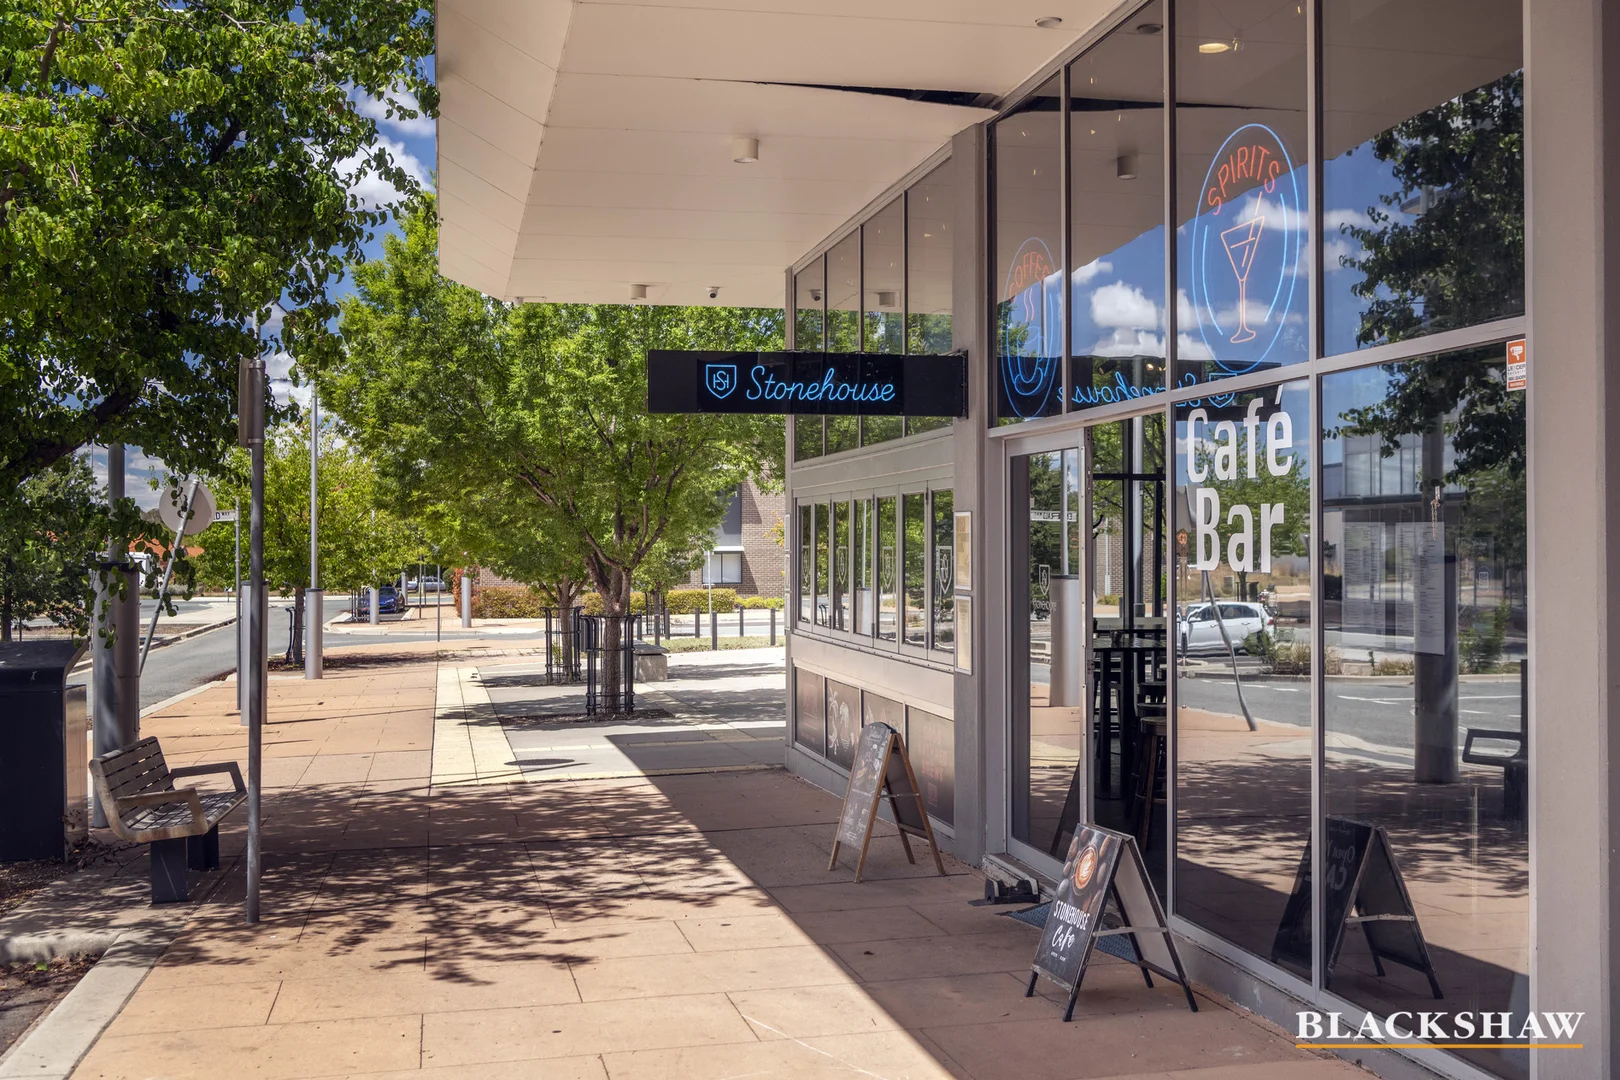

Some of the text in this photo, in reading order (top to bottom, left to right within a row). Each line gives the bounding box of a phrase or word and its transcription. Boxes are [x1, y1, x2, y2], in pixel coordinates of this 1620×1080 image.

[1207, 145, 1280, 216] SPIRITS
[1008, 251, 1050, 304] COFFEE
[745, 364, 896, 402] Stonehouse
[1187, 384, 1293, 483] Café
[1196, 487, 1285, 574] Bar
[1053, 899, 1091, 931] STONEHOUSE
